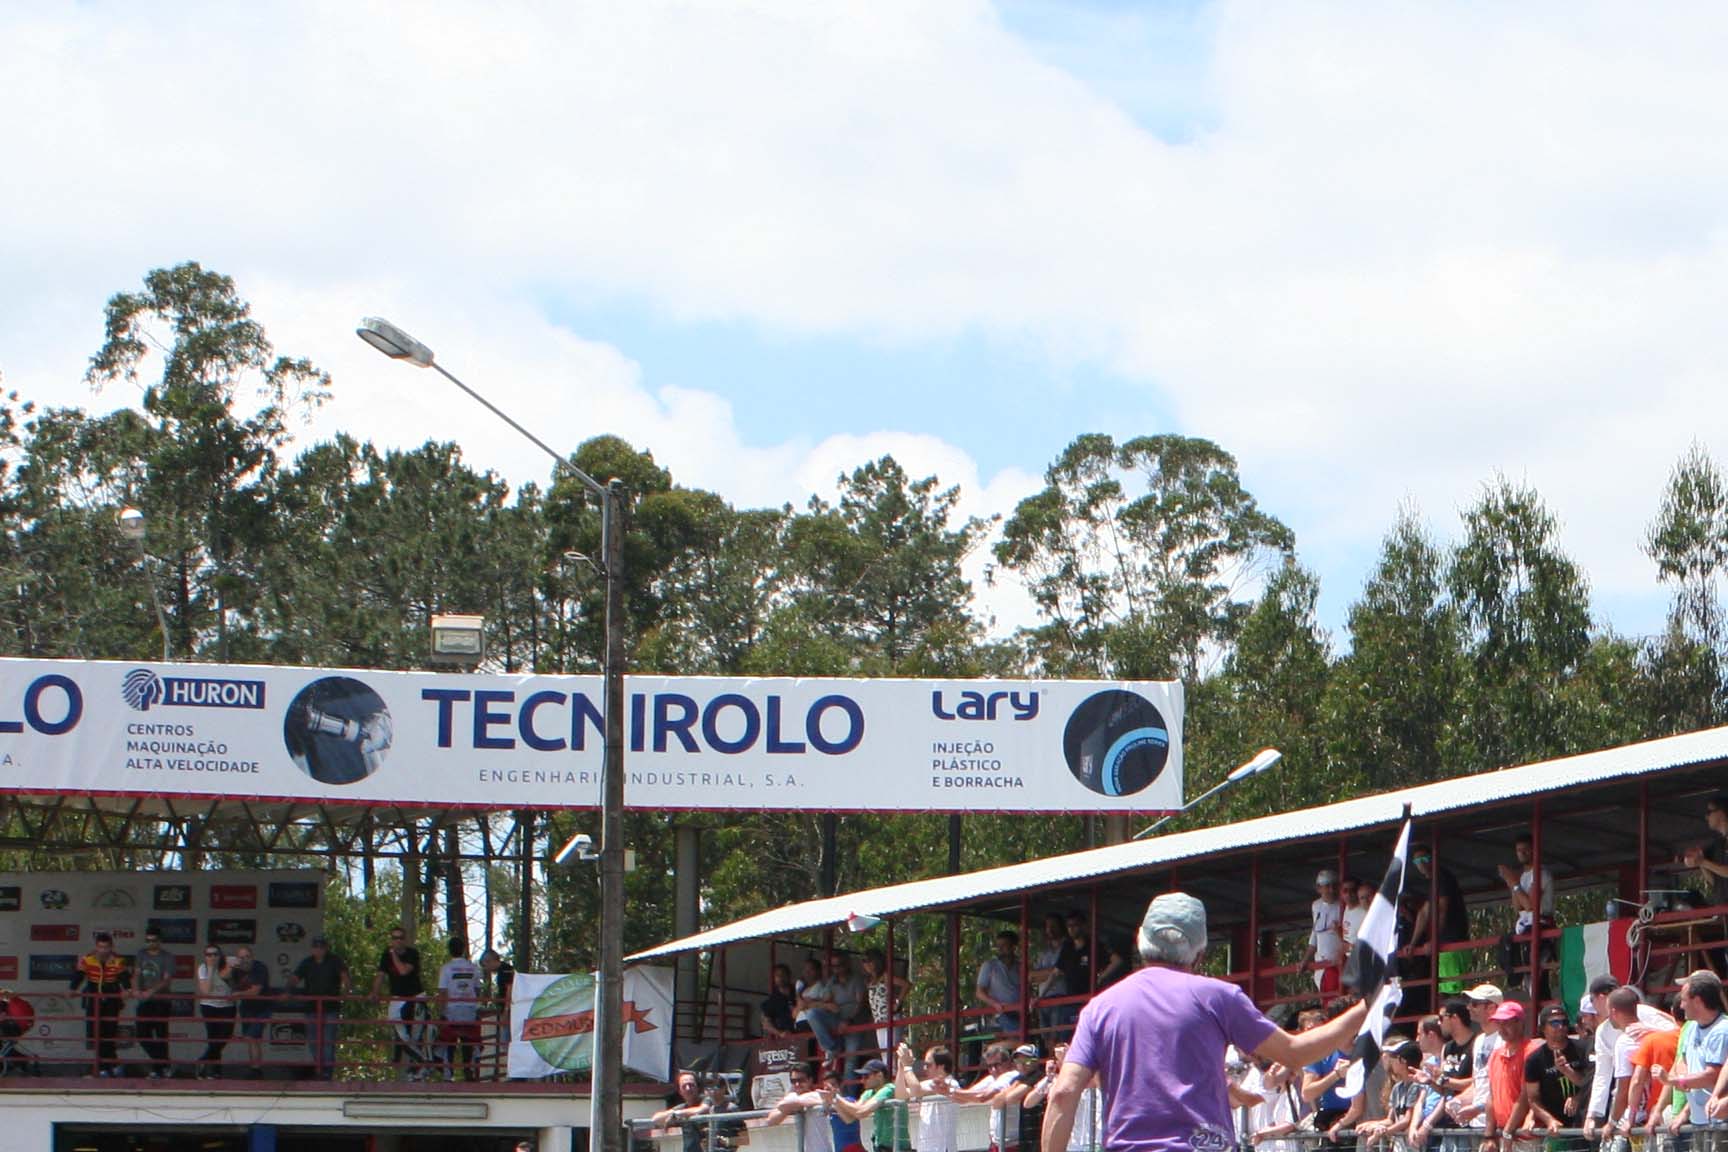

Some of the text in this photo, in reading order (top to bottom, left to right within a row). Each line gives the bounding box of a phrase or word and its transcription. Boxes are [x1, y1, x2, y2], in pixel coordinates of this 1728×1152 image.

[172, 680, 258, 706] HURON
[127, 723, 194, 738] CENTROS
[422, 689, 865, 755] TECNIROLO
[126, 736, 228, 757] MAQUINAÇÃO
[932, 740, 994, 757] INJEÇÃO
[126, 757, 260, 774] ALTA VELOCIDADE
[932, 756, 1001, 772] PLÁSTICO
[479, 769, 597, 785] ENGENHARI
[932, 776, 1024, 790] E BORRACHA
